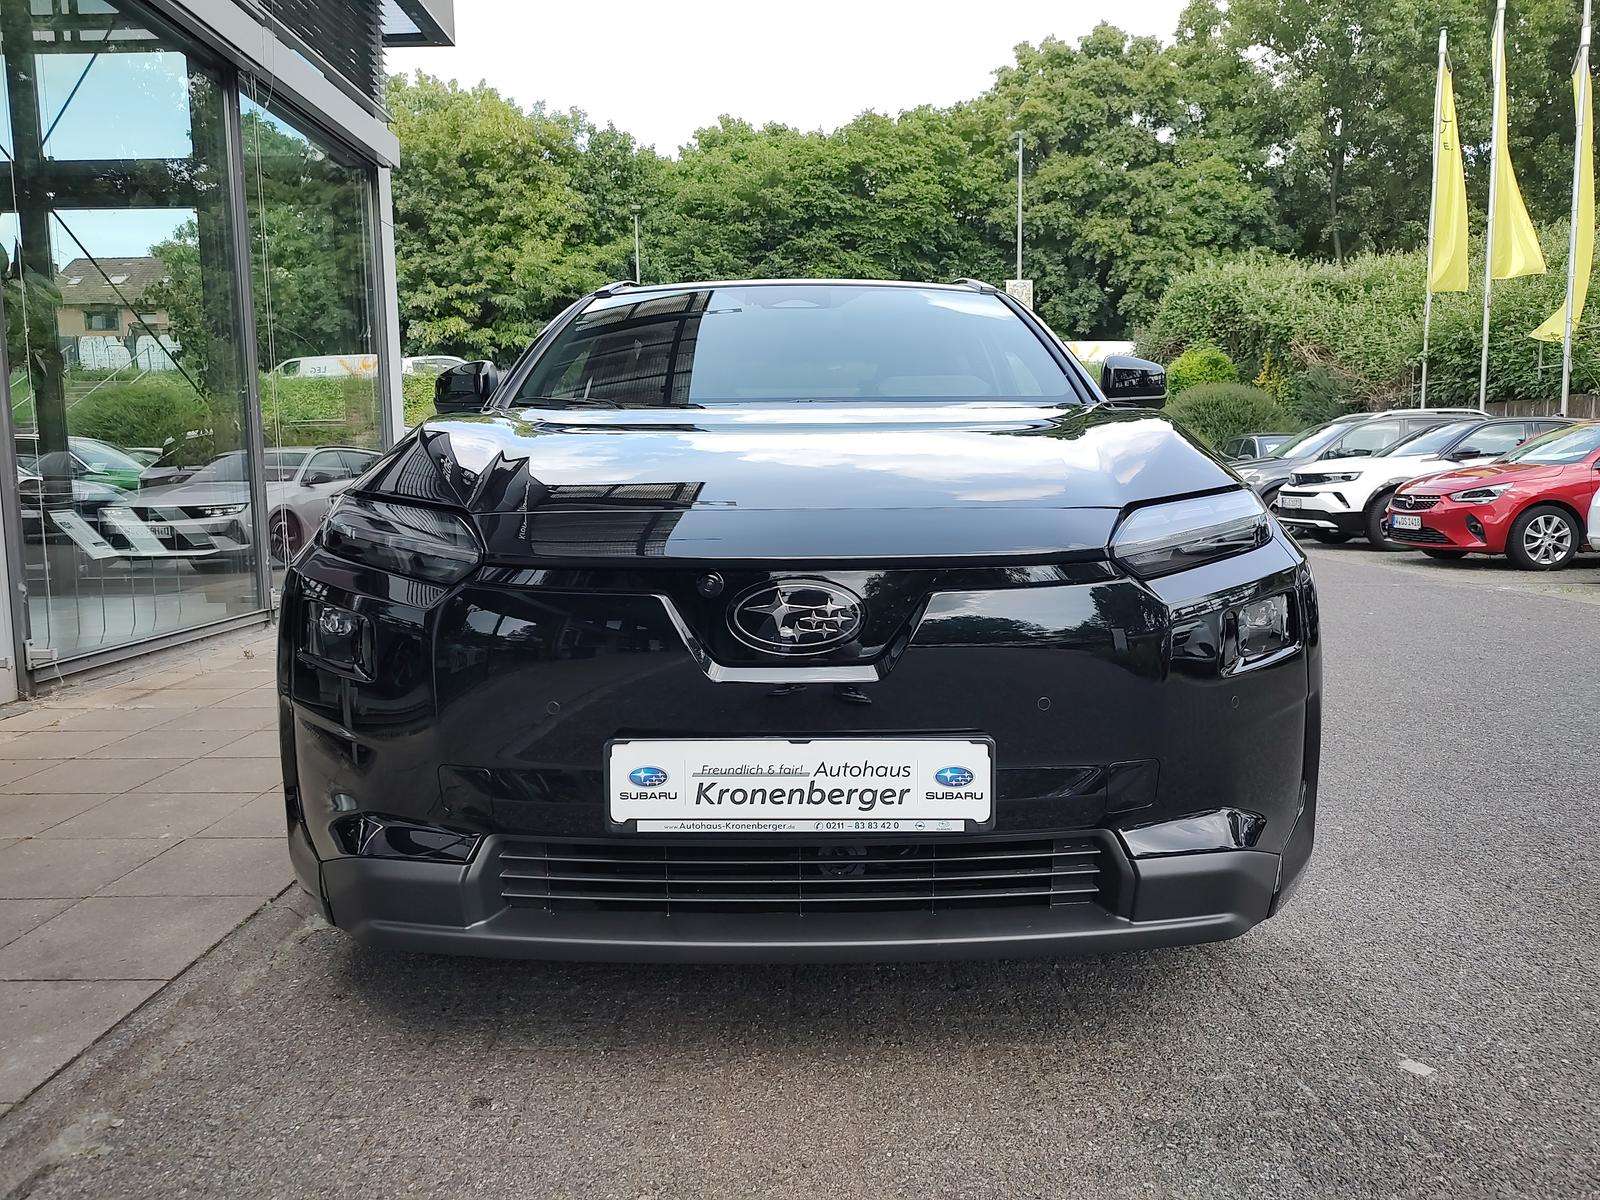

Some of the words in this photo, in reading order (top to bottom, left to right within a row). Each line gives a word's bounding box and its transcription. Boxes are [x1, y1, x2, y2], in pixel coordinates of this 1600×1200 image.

[701, 764, 763, 775] Freundlich
[767, 764, 775, 775] &
[780, 764, 804, 775] fair!
[813, 760, 911, 778] Autohaus
[619, 792, 678, 800] SUBARU
[695, 780, 911, 811] Kronenberger
[925, 791, 984, 800] SUBARU
